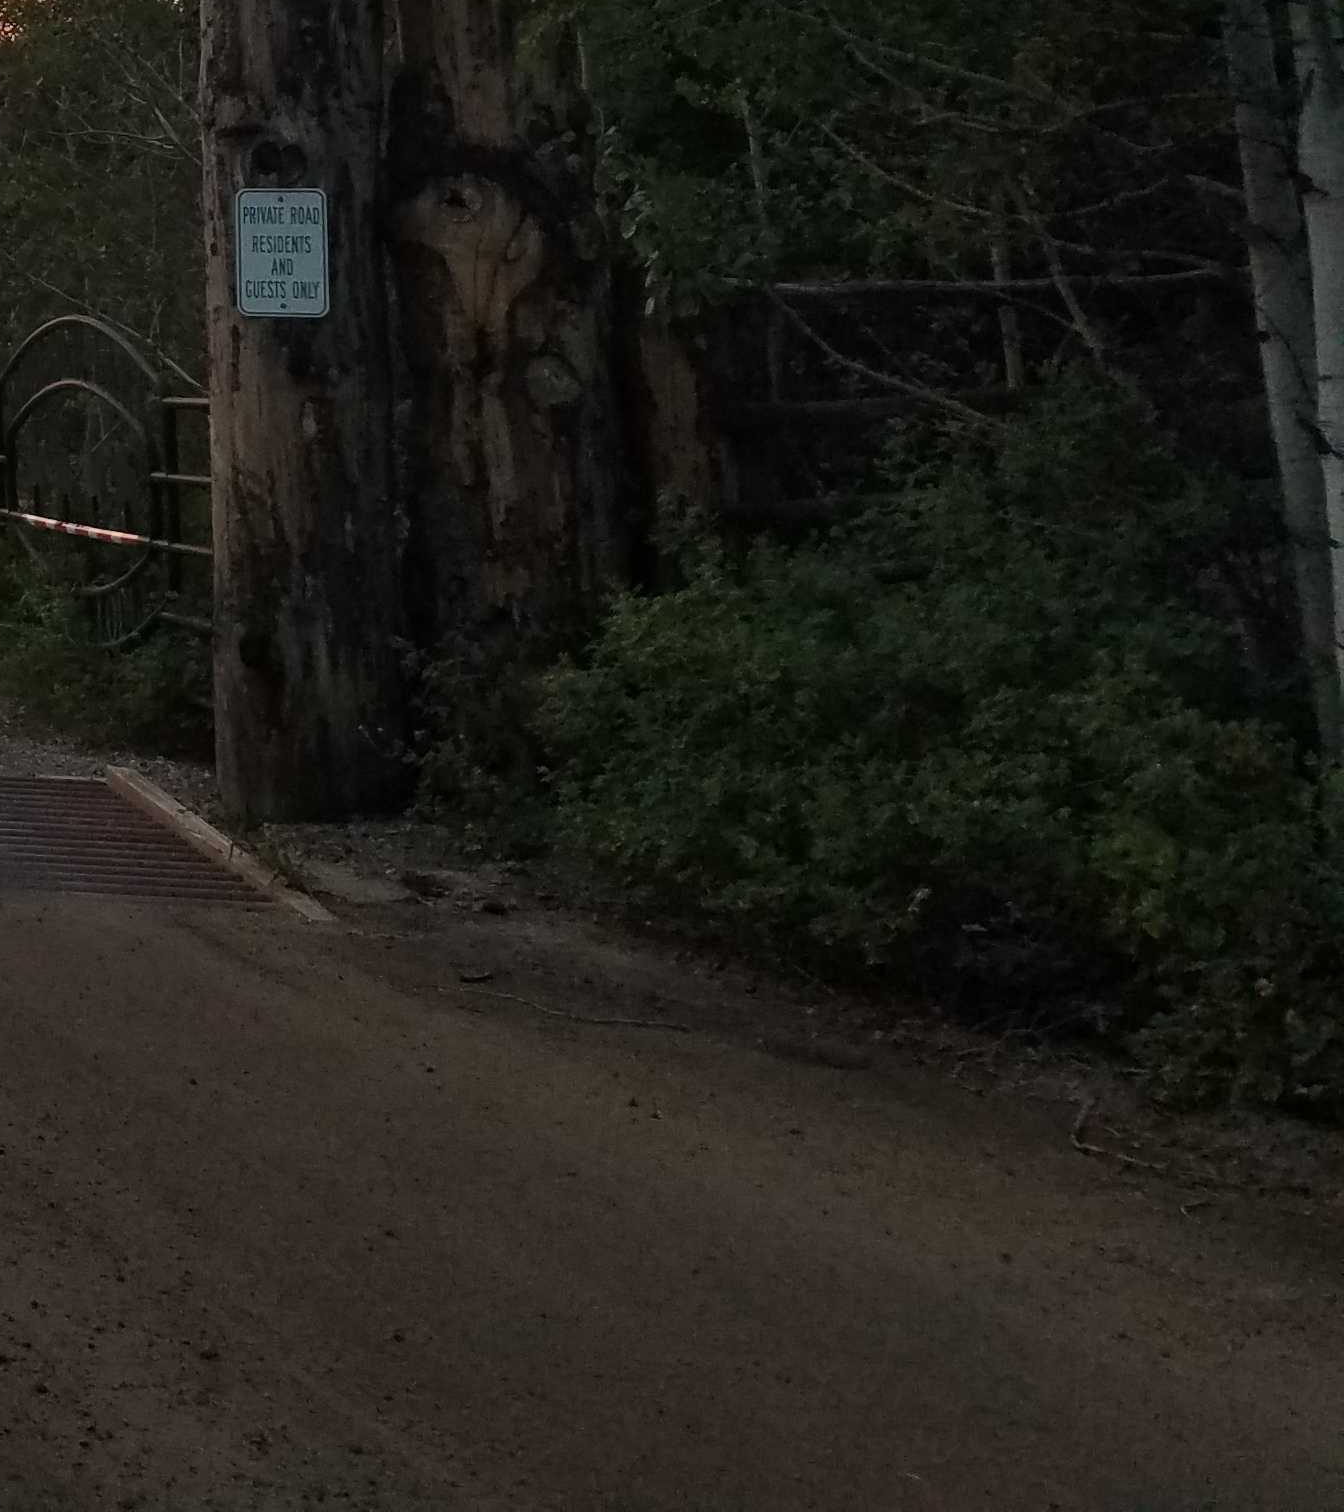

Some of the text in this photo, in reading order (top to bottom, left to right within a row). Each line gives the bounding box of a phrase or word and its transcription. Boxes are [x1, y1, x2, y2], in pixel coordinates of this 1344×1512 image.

[242, 206, 320, 225] PRIVATE ROAD
[251, 235, 311, 254] RESIDENTS
[271, 258, 294, 276] AND
[245, 280, 320, 300] GUESTS ONLY
